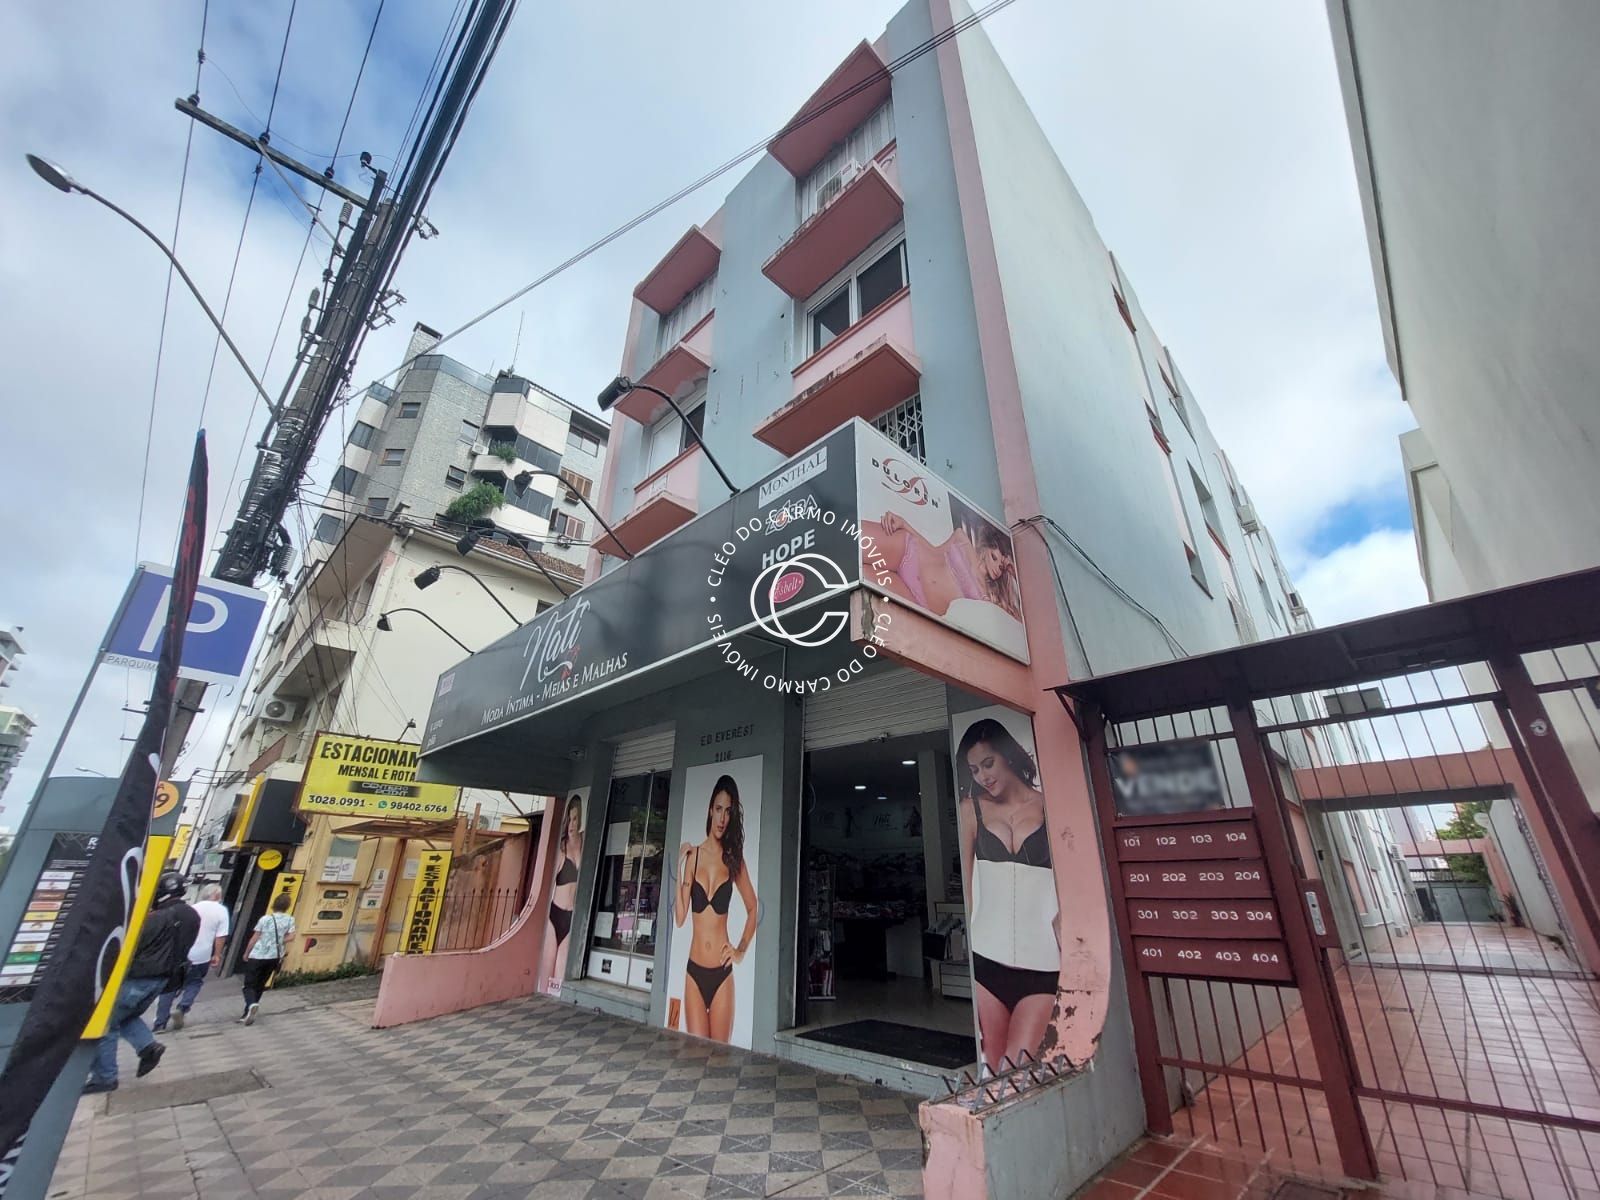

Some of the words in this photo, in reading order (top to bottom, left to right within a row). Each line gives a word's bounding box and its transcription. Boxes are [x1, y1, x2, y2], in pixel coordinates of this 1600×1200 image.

[761, 452, 826, 499] MONTHAL
[871, 457, 938, 508] DULOREN
[762, 528, 816, 571] HOPE
[519, 596, 591, 691] Nati
[481, 706, 503, 726] MODA
[541, 677, 571, 701] MEIAS
[573, 674, 580, 688] E
[581, 652, 628, 686] MALHAS
[338, 764, 379, 780] MENSAL
[382, 769, 388, 780] E
[308, 794, 365, 808] 3028.0991
[390, 801, 448, 814] 98402.6764
[1124, 838, 1141, 847] 101
[1156, 836, 1177, 846] 102
[1191, 834, 1213, 844] 103
[1225, 832, 1247, 842] 104
[1129, 873, 1150, 882] 201
[1162, 873, 1187, 882] 202
[1199, 872, 1225, 881] 203
[1234, 871, 1260, 881] 204
[1137, 910, 1159, 919] 301
[1172, 910, 1198, 920] 302
[1211, 910, 1239, 921] 303
[1246, 911, 1273, 921] 304
[1142, 948, 1162, 957] 401
[1177, 950, 1202, 960] 402
[1215, 951, 1241, 961] 403
[1252, 953, 1279, 963] 404
